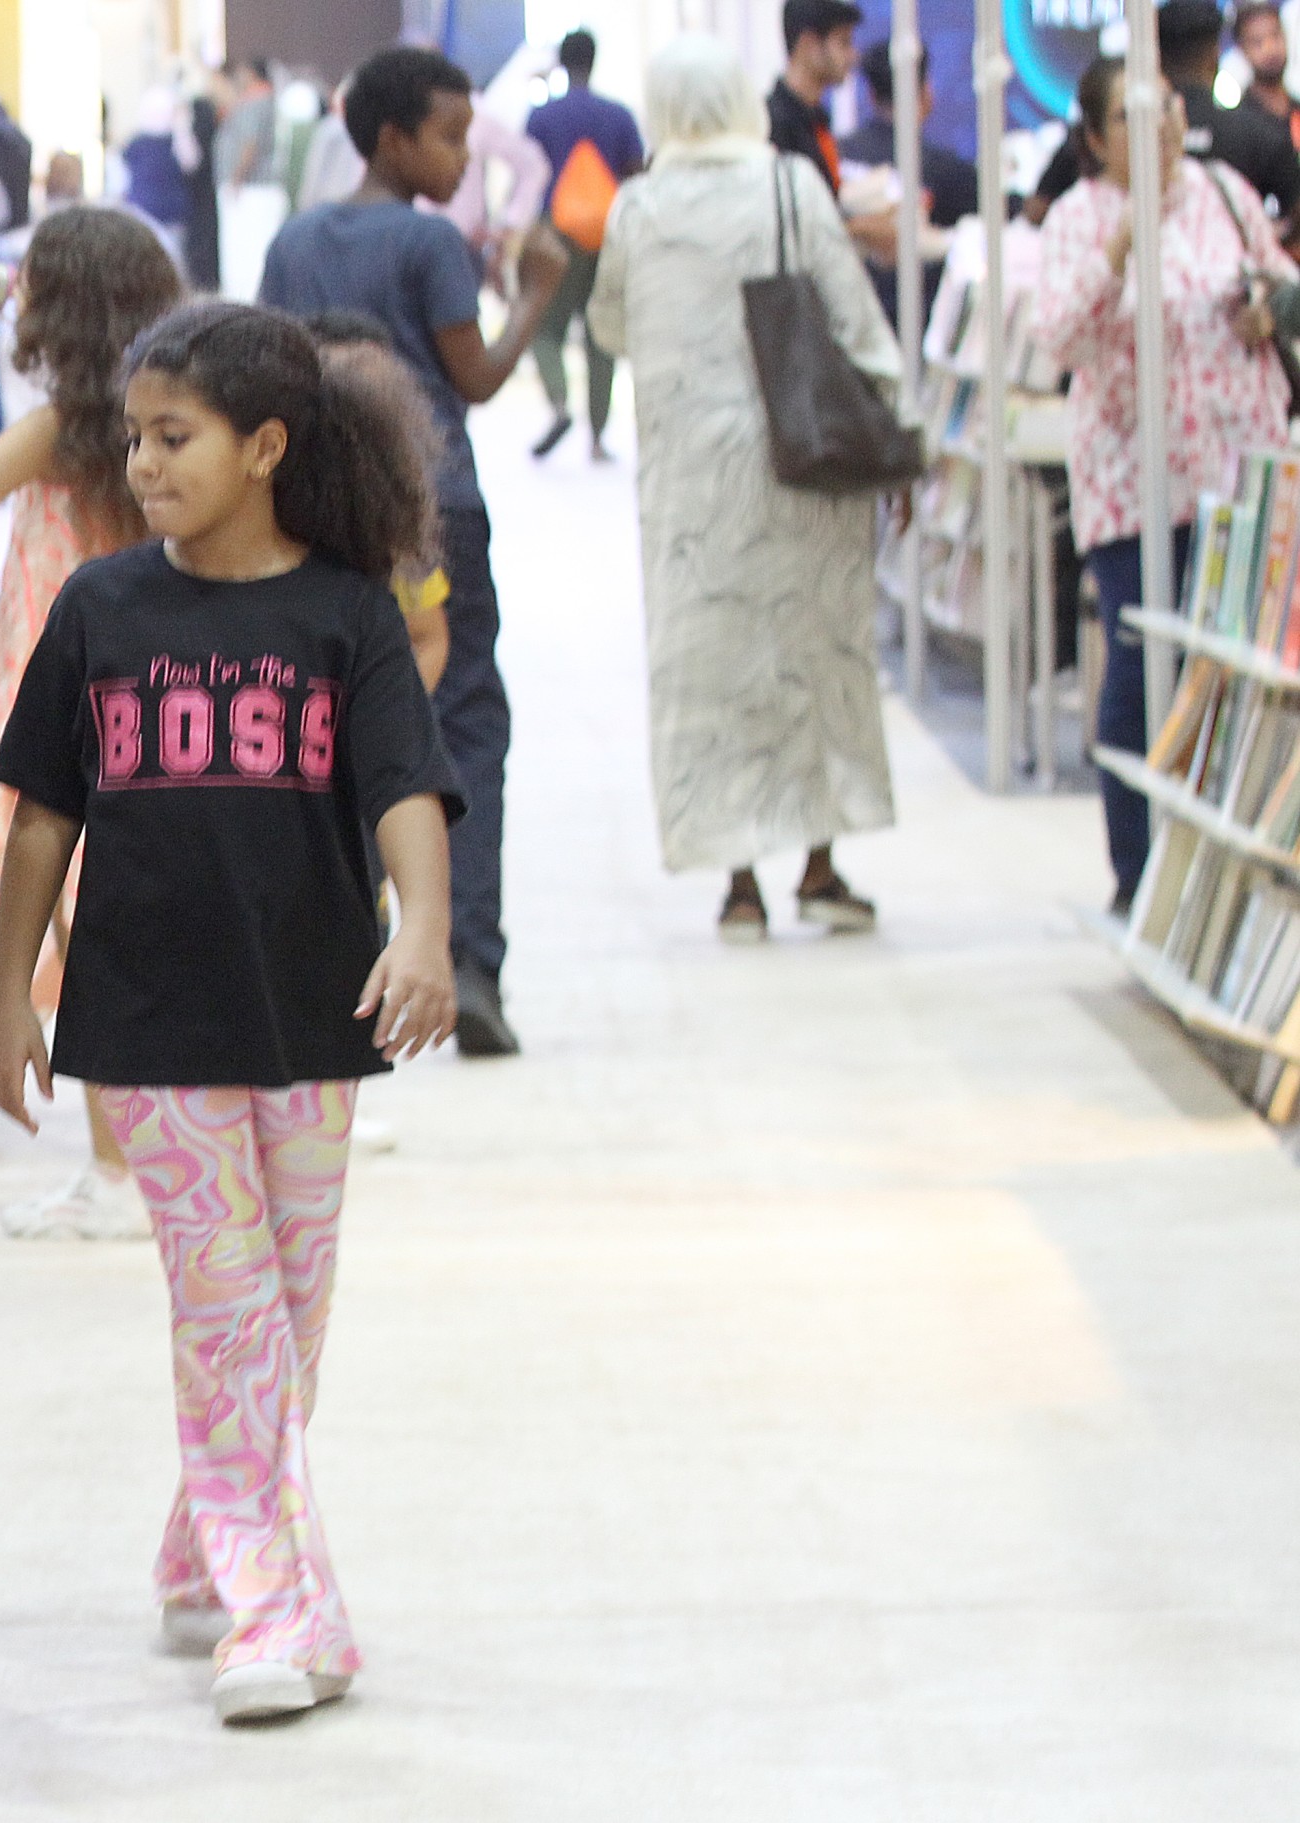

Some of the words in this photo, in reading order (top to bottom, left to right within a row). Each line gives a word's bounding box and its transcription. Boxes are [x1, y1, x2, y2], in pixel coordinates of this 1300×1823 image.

[150, 652, 200, 688] Now
[208, 651, 241, 687] I'm
[101, 683, 336, 784] BOSS
